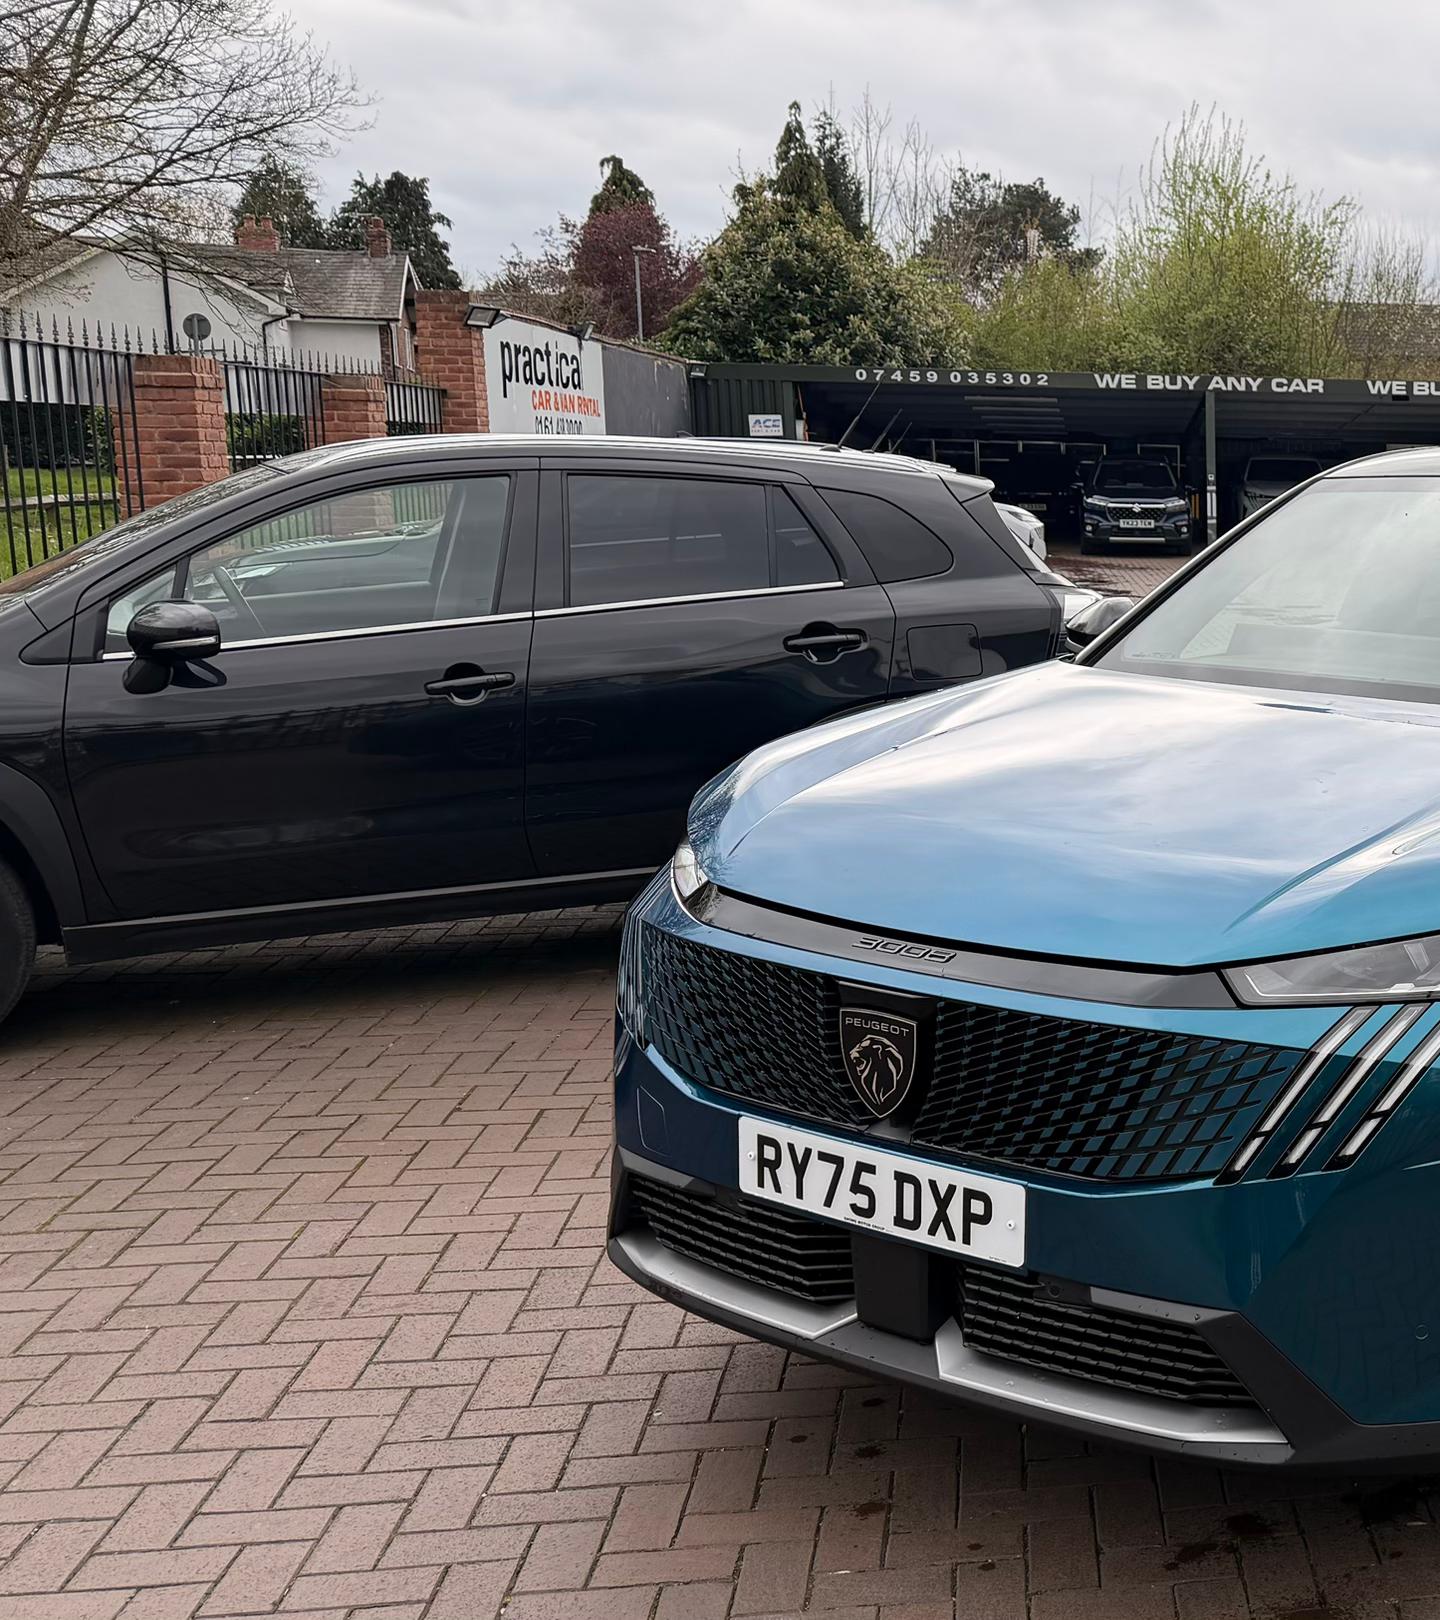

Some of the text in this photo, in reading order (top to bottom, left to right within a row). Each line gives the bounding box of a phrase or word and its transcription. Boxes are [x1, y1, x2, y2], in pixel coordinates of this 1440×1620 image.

[855, 369, 1049, 385] 07459 035302
[1094, 374, 1324, 393] WE BUY ANY CAR
[1367, 380, 1407, 394] WE
[531, 390, 552, 411] CAR
[554, 392, 560, 412] &
[852, 937, 957, 963] 3008
[845, 1017, 909, 1037] PEUGEOT
[756, 1134, 993, 1246] RY75 DXP
